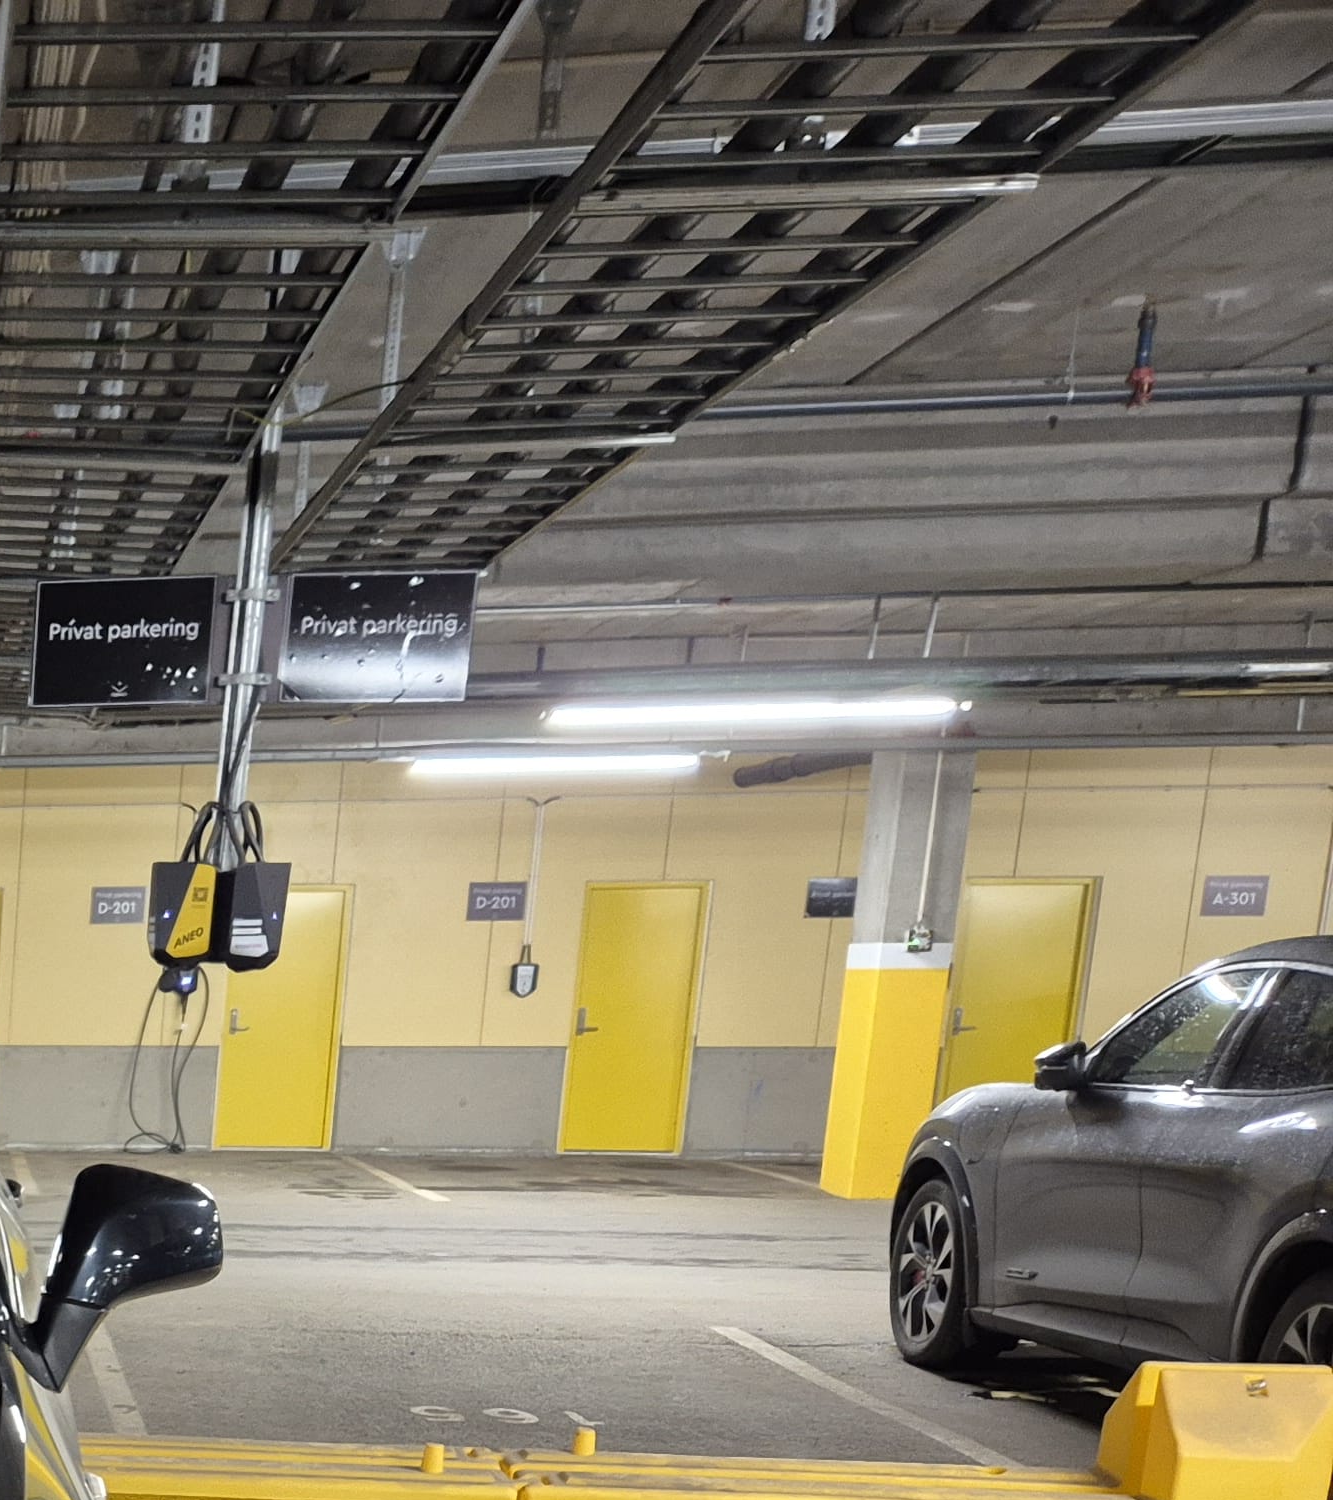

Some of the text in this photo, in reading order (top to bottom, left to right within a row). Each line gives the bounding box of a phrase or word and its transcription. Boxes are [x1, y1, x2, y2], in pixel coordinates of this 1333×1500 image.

[107, 617, 200, 643] parkering
[362, 612, 459, 639] parkering
[475, 896, 517, 909] D-201
[1212, 892, 1256, 905] A-301
[97, 901, 136, 914] D-201
[173, 927, 204, 949] ANEO
